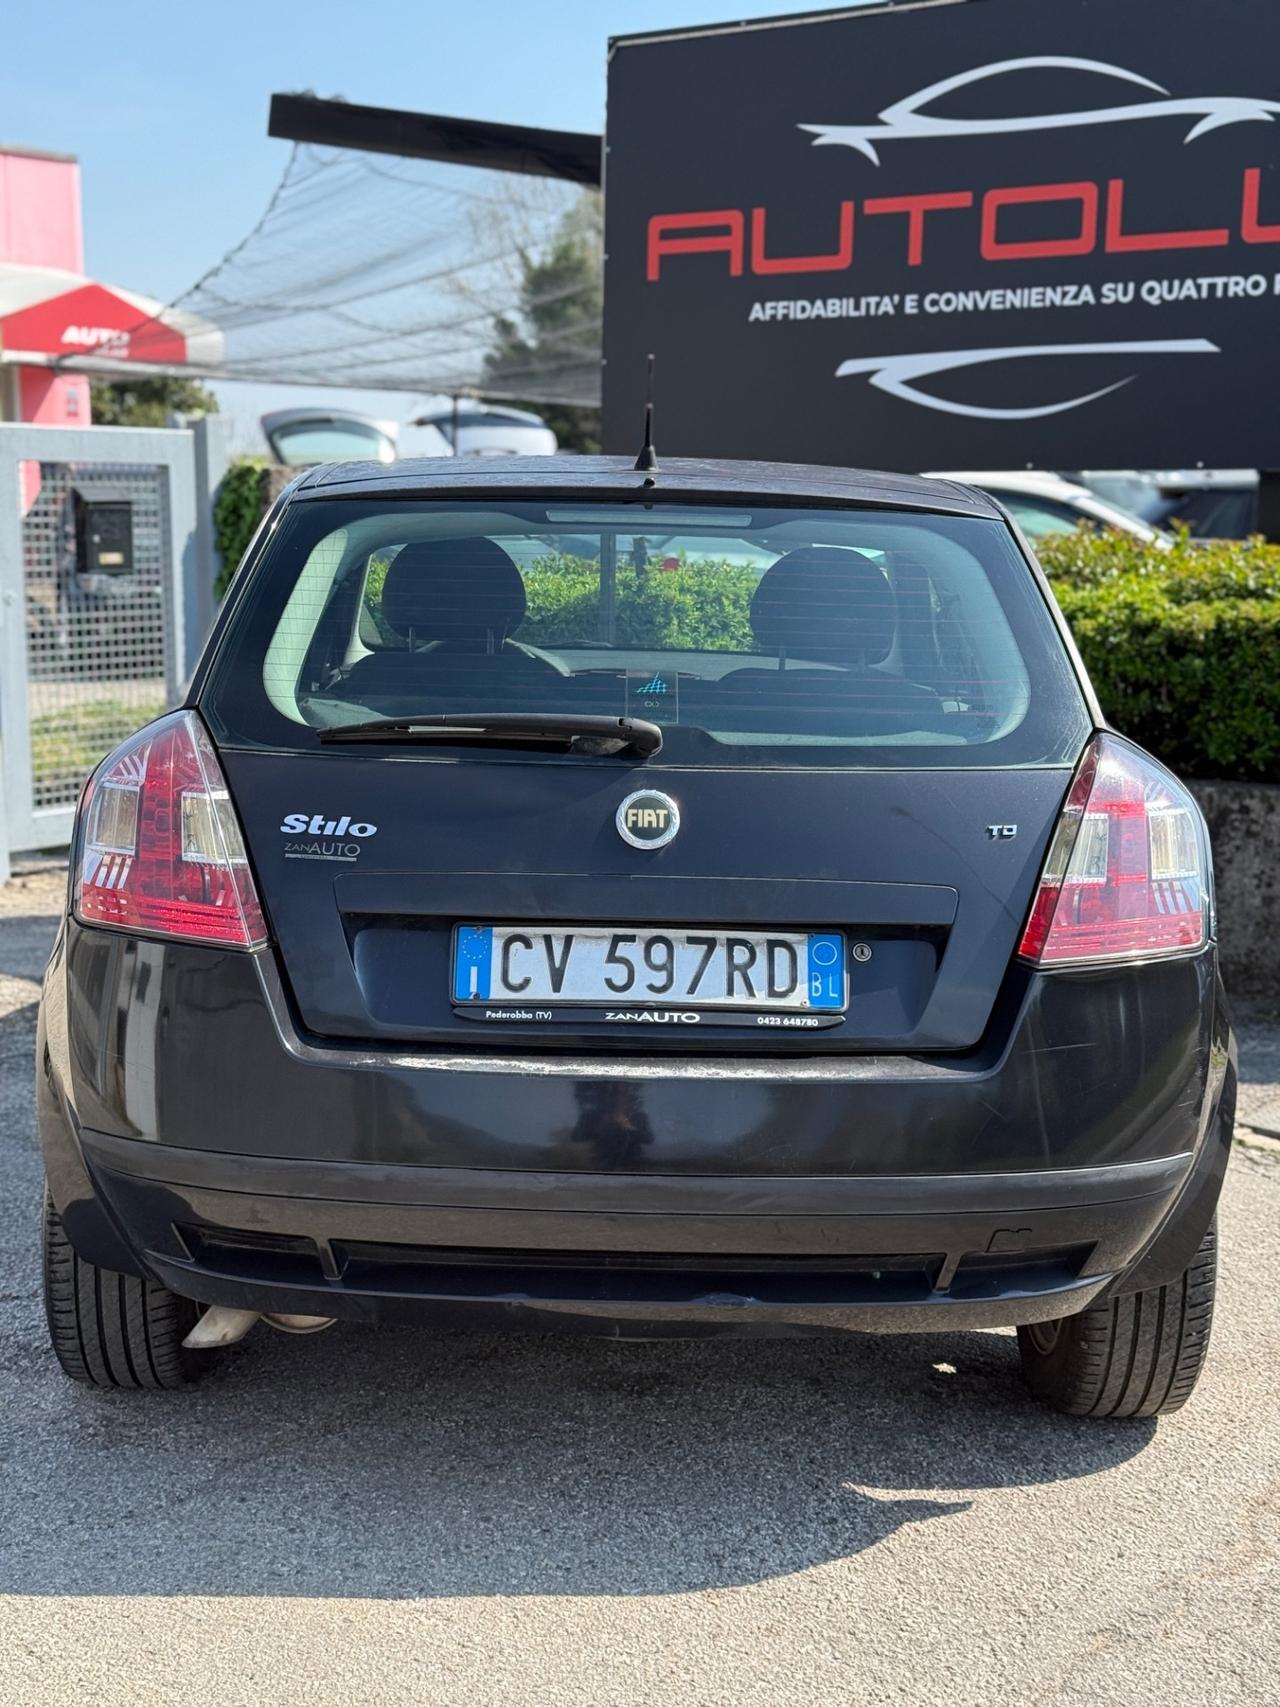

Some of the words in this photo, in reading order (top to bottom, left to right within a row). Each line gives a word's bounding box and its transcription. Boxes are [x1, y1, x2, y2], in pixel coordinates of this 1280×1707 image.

[748, 294, 899, 322] AFFIDABILITA'
[904, 294, 919, 314] E
[923, 284, 1096, 314] CONVENIENZA
[1100, 281, 1135, 305] SU
[1140, 273, 1268, 306] QUATTRO
[61, 325, 131, 347] AUTO
[280, 814, 378, 837] Stilo
[627, 808, 668, 828] FIAT
[284, 842, 361, 857] ZANAUTO
[502, 933, 574, 993] CV
[604, 933, 799, 1000] 597RD
[811, 972, 839, 999] BL
[485, 1010, 533, 1020] Pederobba
[535, 1011, 552, 1021] (TV)
[605, 1011, 701, 1024] ZANAUTO
[757, 1016, 781, 1026] 0423
[783, 1017, 819, 1027] 648780
